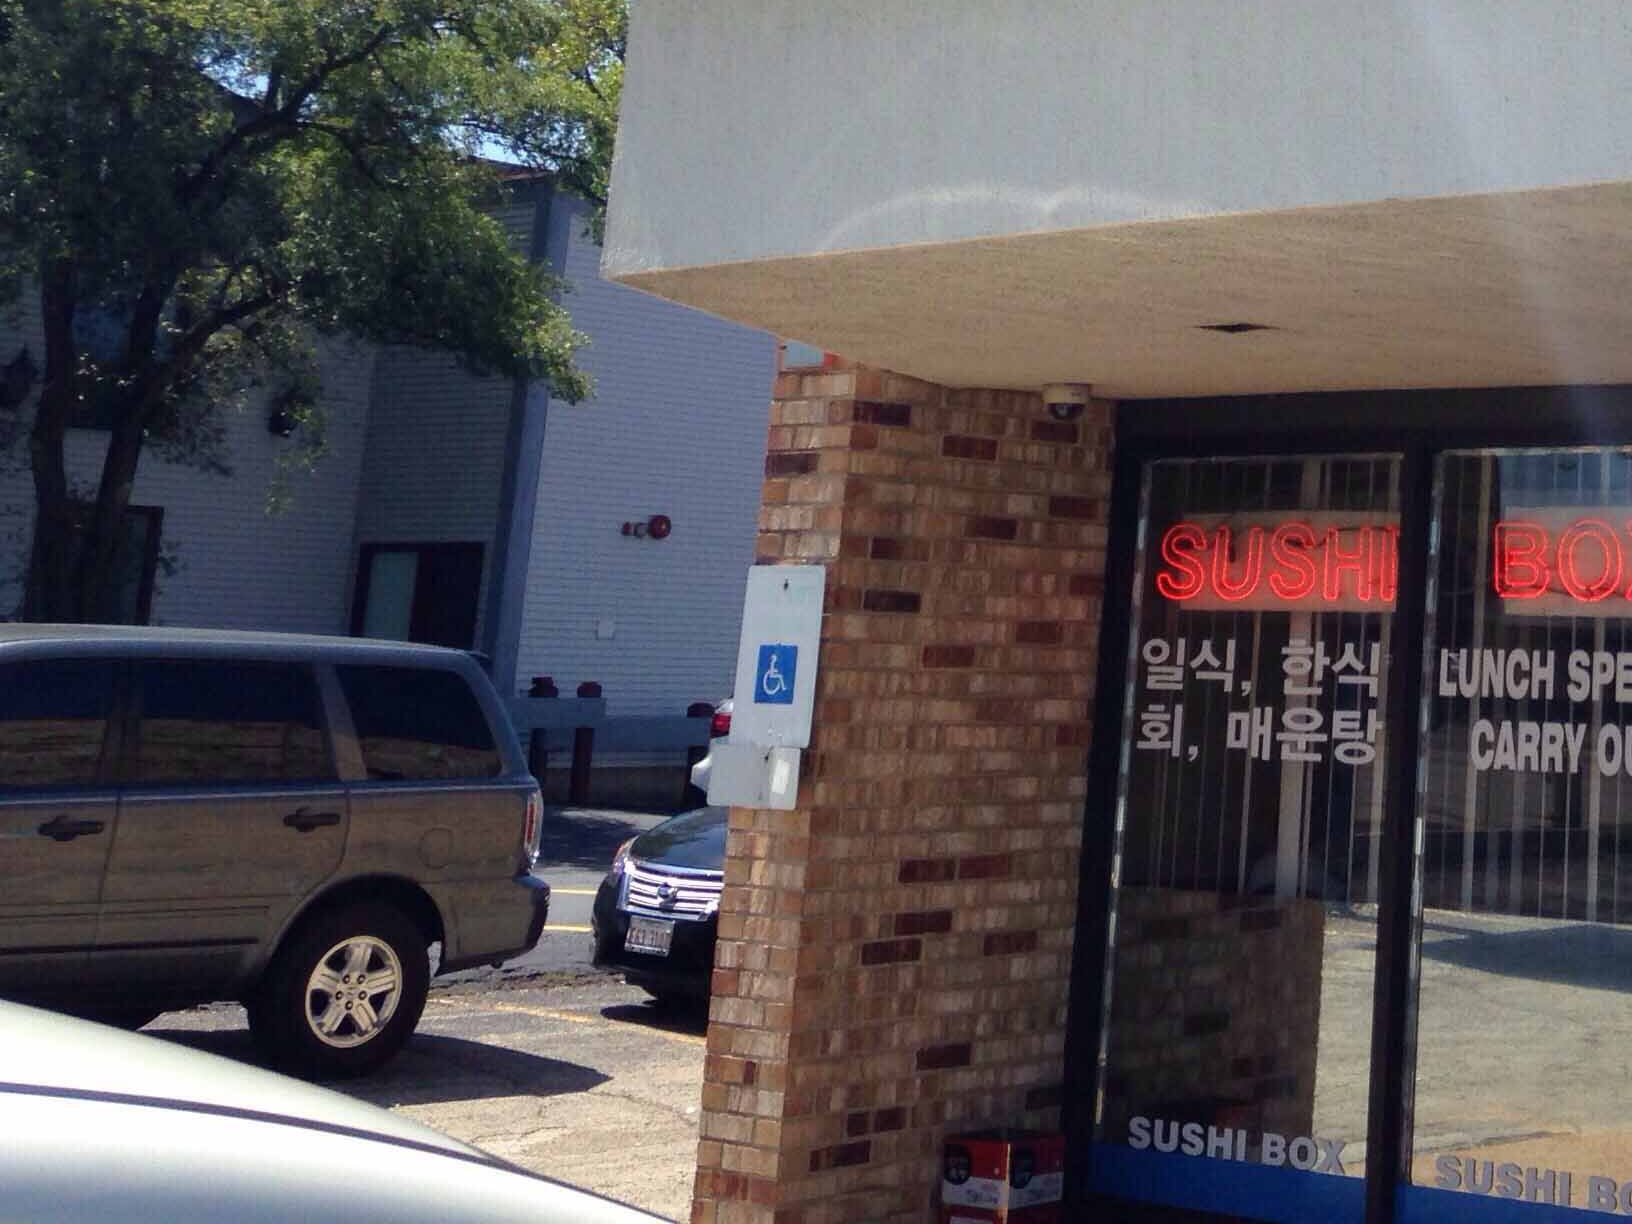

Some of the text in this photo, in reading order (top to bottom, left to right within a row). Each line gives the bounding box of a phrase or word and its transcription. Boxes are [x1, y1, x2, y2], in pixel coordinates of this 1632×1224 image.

[1156, 522, 1397, 602] SUSHI
[1142, 637, 1381, 698] 일식, 한식
[1440, 648, 1553, 700] LUNCH
[1136, 704, 1380, 765] 회, 매운탕
[1470, 718, 1587, 775] CARRY
[1127, 1116, 1346, 1176] SUSHI BOX
[1434, 1155, 1572, 1209] SUSHI
